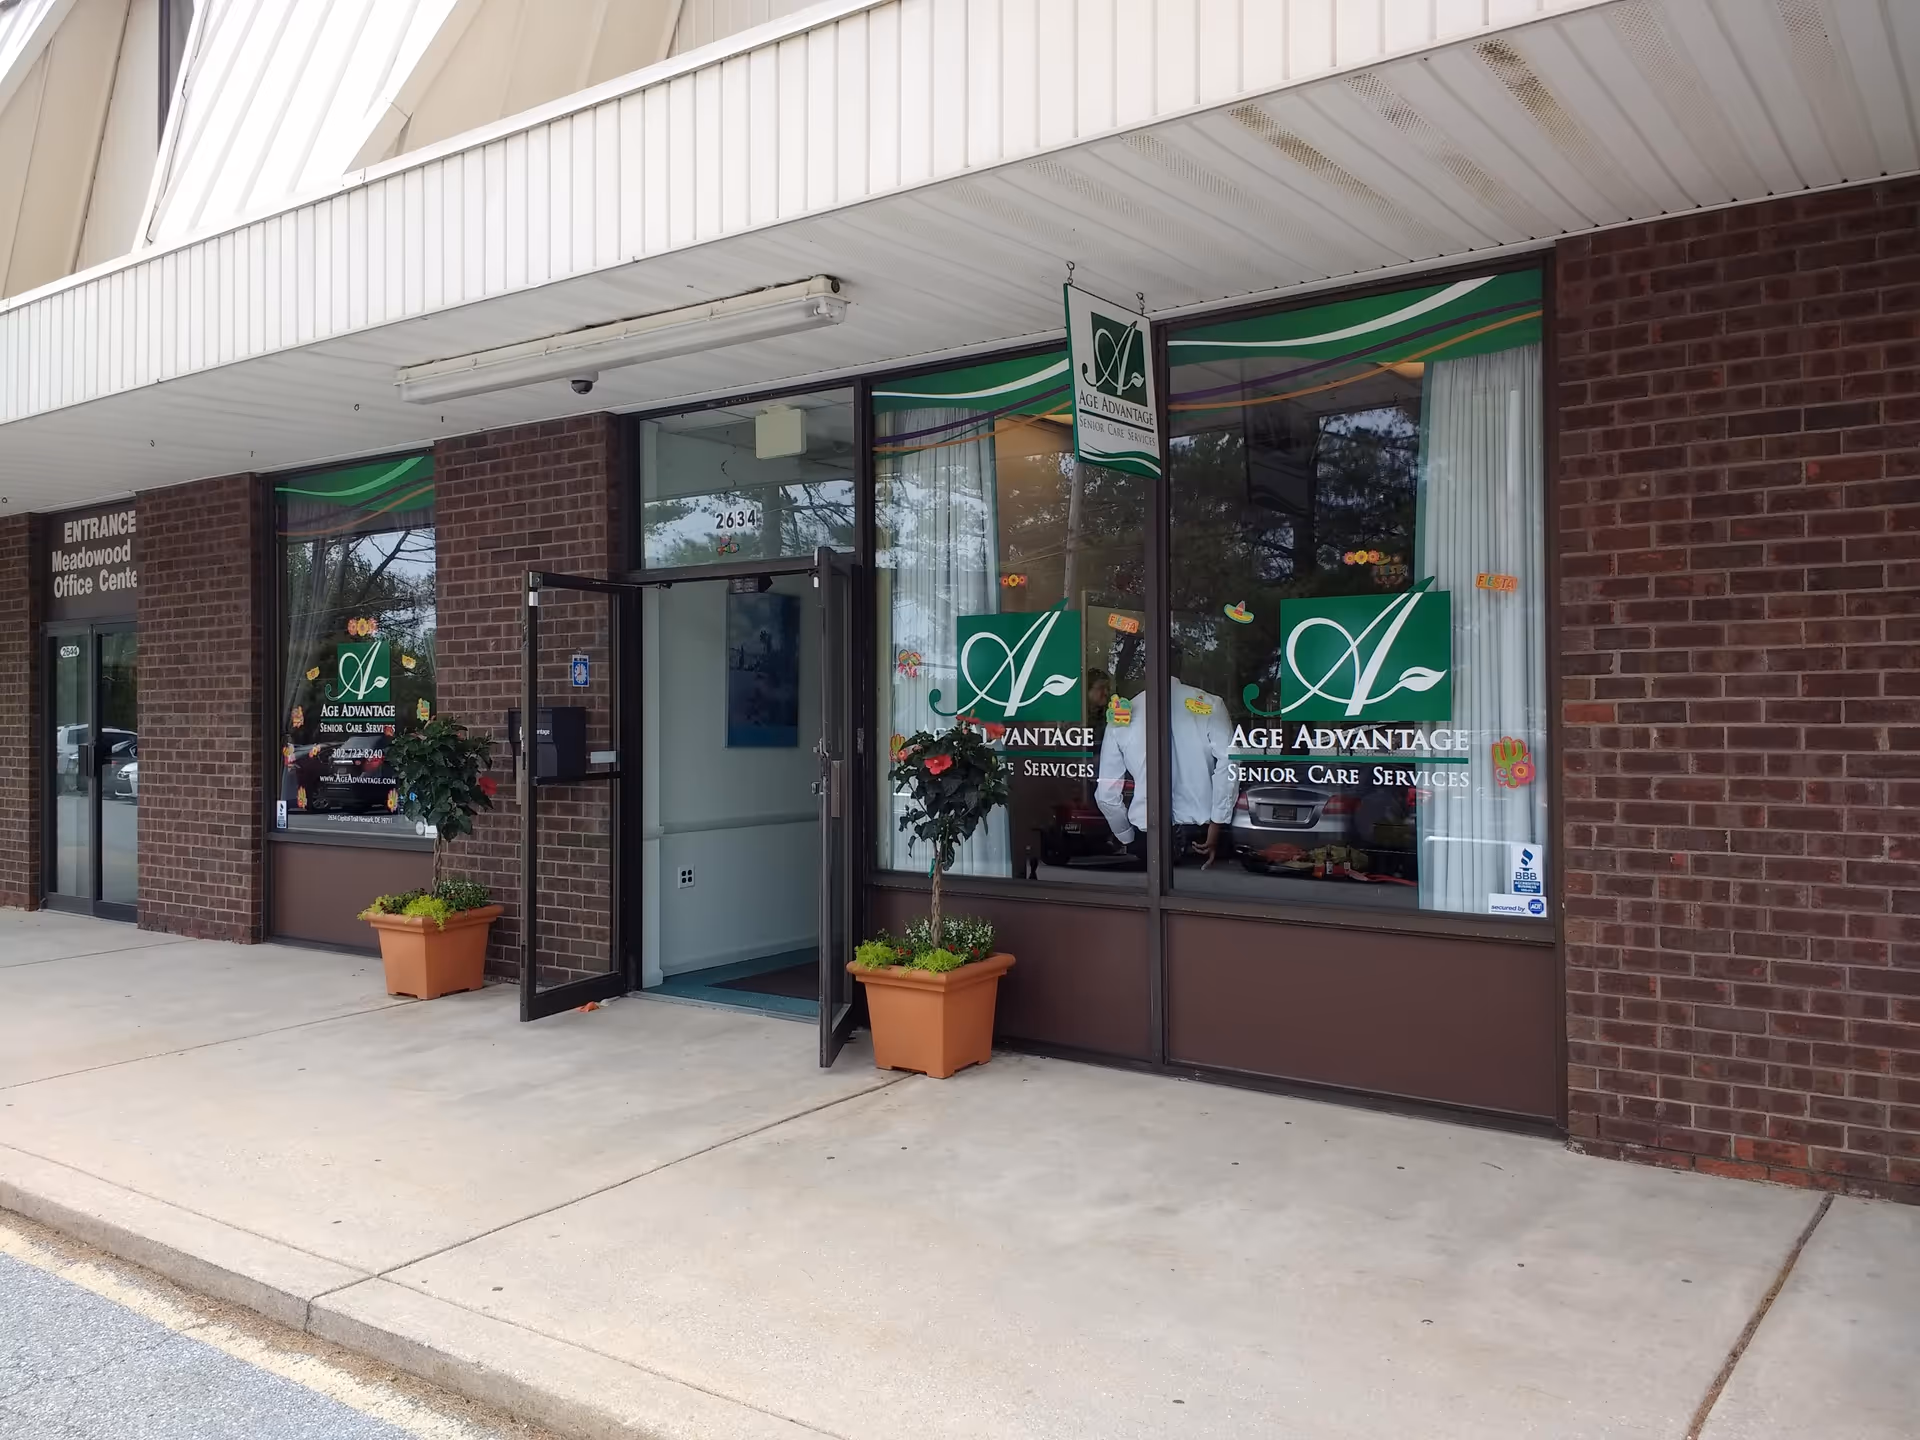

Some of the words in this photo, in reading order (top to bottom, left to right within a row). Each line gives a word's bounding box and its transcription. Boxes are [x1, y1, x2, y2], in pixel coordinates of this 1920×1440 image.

[1079, 389, 1099, 410] AGE
[1101, 396, 1154, 426] ADVANTAGE
[1079, 415, 1104, 433] SENIOR
[1107, 423, 1125, 439] CARE
[1127, 429, 1156, 447] SERVICES
[64, 510, 137, 544] ENTRANCE
[716, 509, 756, 529] 2634
[52, 538, 131, 572] Meadowood
[54, 573, 93, 598] Office
[99, 566, 138, 592] Cente
[320, 703, 339, 717] AGE
[341, 703, 396, 717] ADVANTAGE
[319, 722, 344, 733] SENIOR
[345, 722, 363, 733] CARE
[1228, 723, 1284, 749] AGE
[1291, 723, 1469, 751] ADVANTAGE
[1024, 759, 1094, 778] SERVICES
[1227, 763, 1299, 783] SENIOR
[1307, 765, 1360, 784] CARE
[1372, 766, 1470, 787] SERVICES
[1515, 872, 1537, 880] BBB
